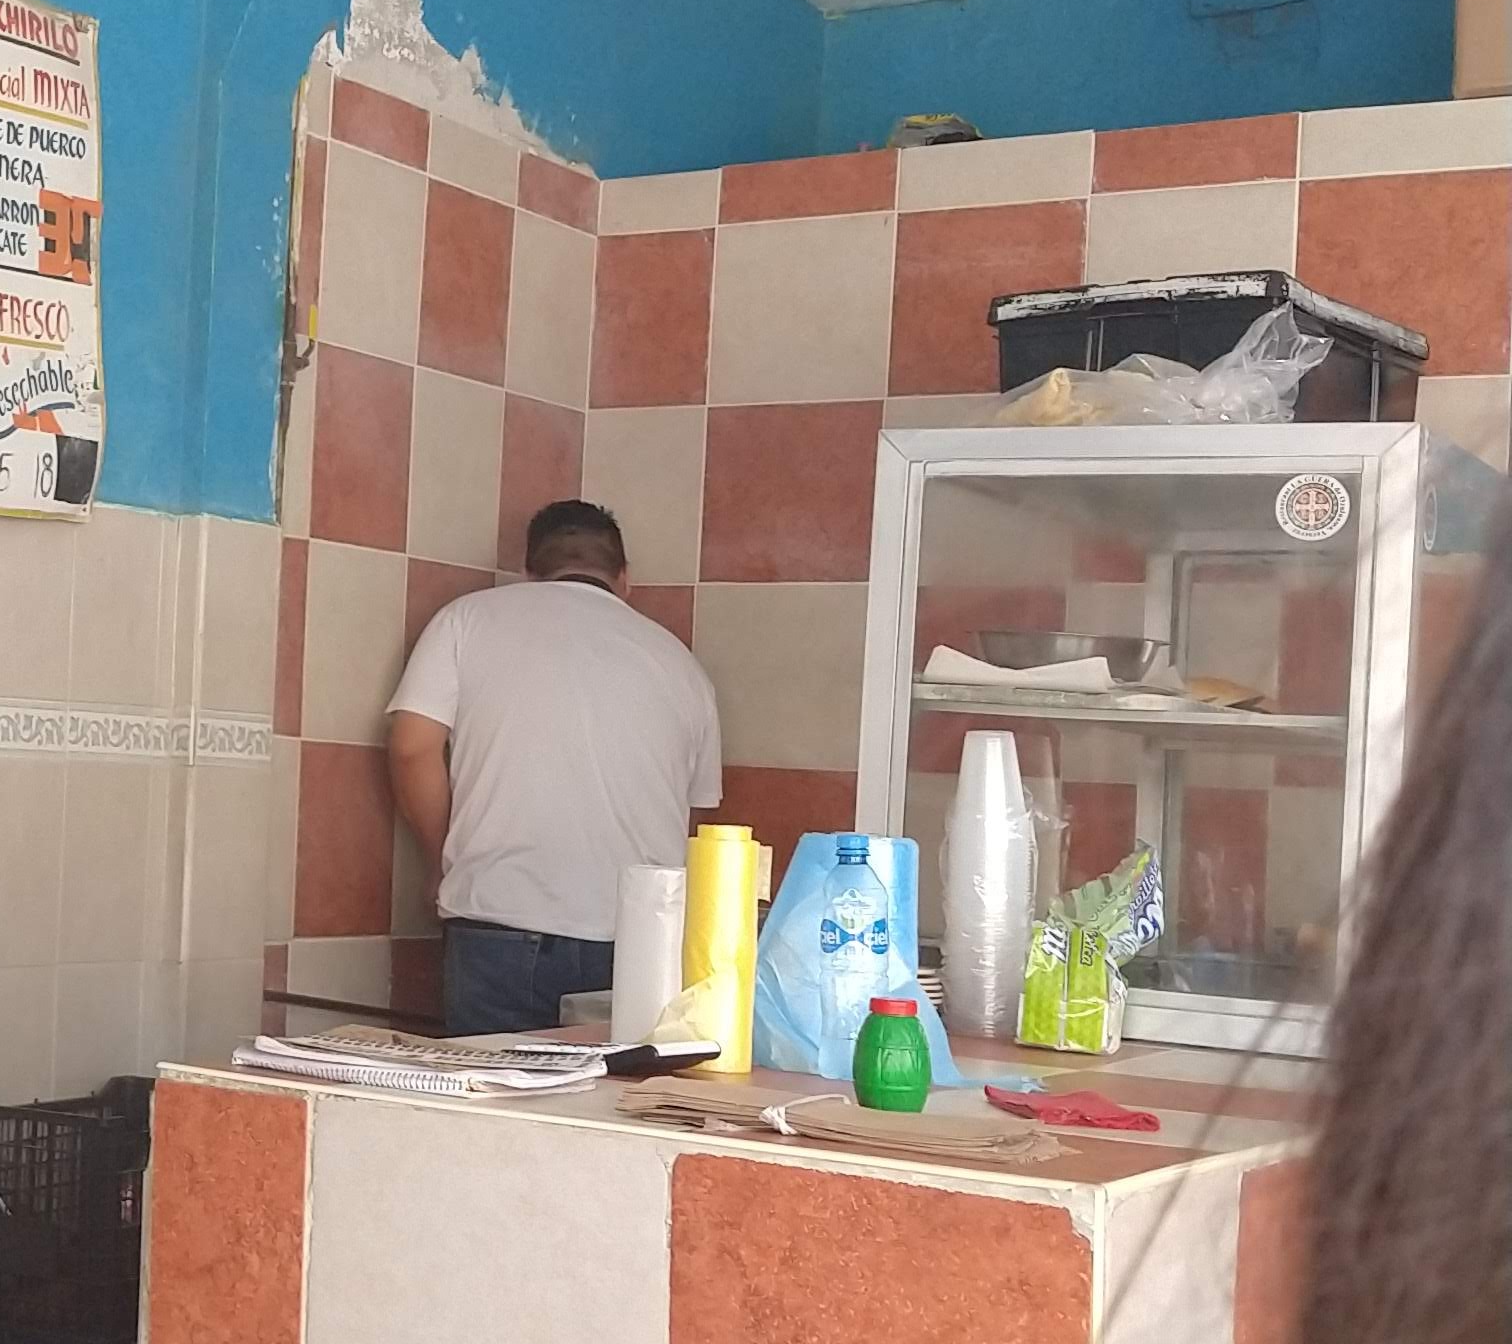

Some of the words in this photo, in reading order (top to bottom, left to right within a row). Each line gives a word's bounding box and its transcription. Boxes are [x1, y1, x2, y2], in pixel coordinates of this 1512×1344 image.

[33, 68, 91, 119] MIXTA
[7, 121, 24, 147] DE
[29, 125, 86, 160] PUERCO
